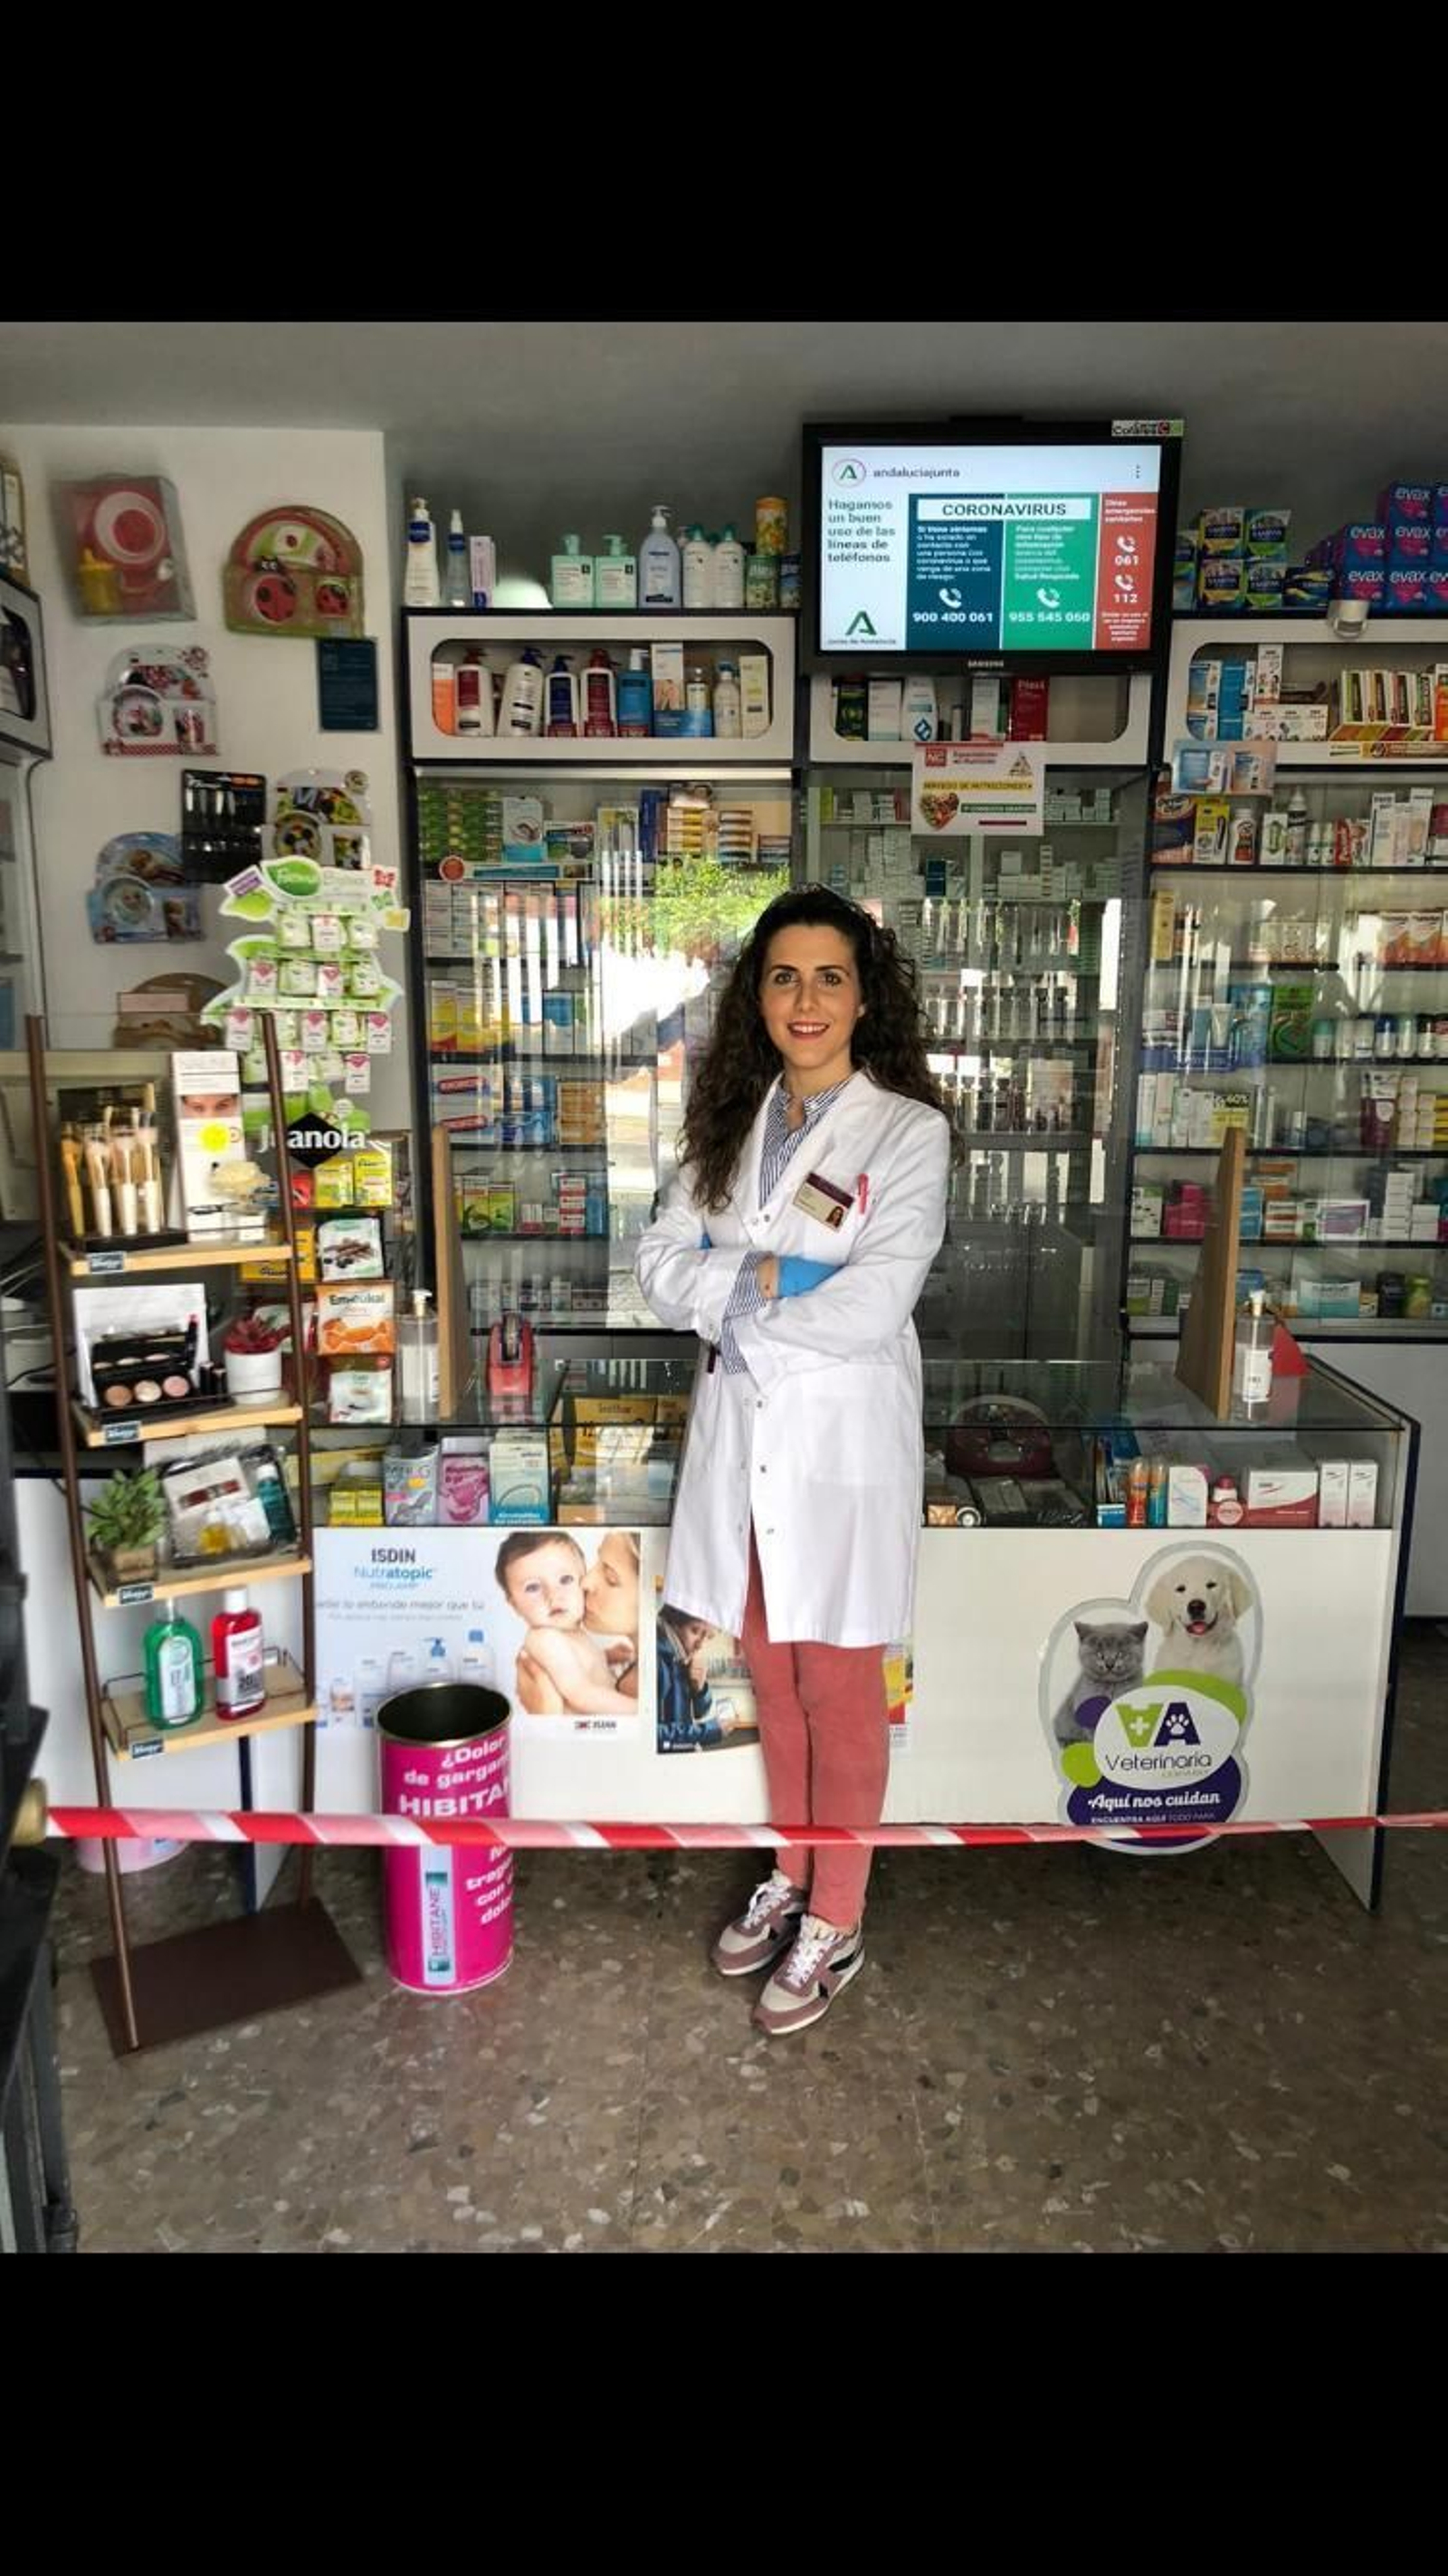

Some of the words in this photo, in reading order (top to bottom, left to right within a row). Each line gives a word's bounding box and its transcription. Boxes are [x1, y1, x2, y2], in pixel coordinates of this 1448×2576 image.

[873, 467, 959, 480] andaluciajunta
[1395, 487, 1430, 501] evax
[828, 500, 892, 511] Hagamos
[942, 503, 1067, 517] CORONAVIRUS
[828, 514, 845, 523] un
[848, 512, 881, 523] buen
[828, 529, 852, 537] uso
[856, 527, 873, 536] de
[876, 526, 895, 536] las
[1349, 526, 1386, 539] evax
[1395, 526, 1430, 539] evax
[827, 539, 867, 549] líneas
[872, 539, 889, 549] de
[827, 552, 891, 562] teléfonos
[1114, 555, 1139, 566] 061
[1348, 570, 1385, 582] evax
[1390, 570, 1427, 583] evax
[1113, 594, 1138, 603] 112
[912, 612, 938, 622] 900
[941, 612, 966, 622] 400
[969, 612, 993, 622] 061
[1009, 612, 1034, 622] 955
[1037, 612, 1062, 622] 545
[371, 1548, 416, 1563] ISDIN
[354, 1566, 433, 1580] Nutratopic
[441, 1735, 506, 1769] ¿Dolor
[1105, 1751, 1212, 1771] Veterinaria
[404, 1770, 429, 1786] de
[1088, 1791, 1130, 1813] Aquí
[1132, 1794, 1163, 1808] nos
[1165, 1790, 1221, 1807] cuidan
[1091, 1815, 1144, 1824] ENCUENTRA
[476, 1883, 505, 1907] con
